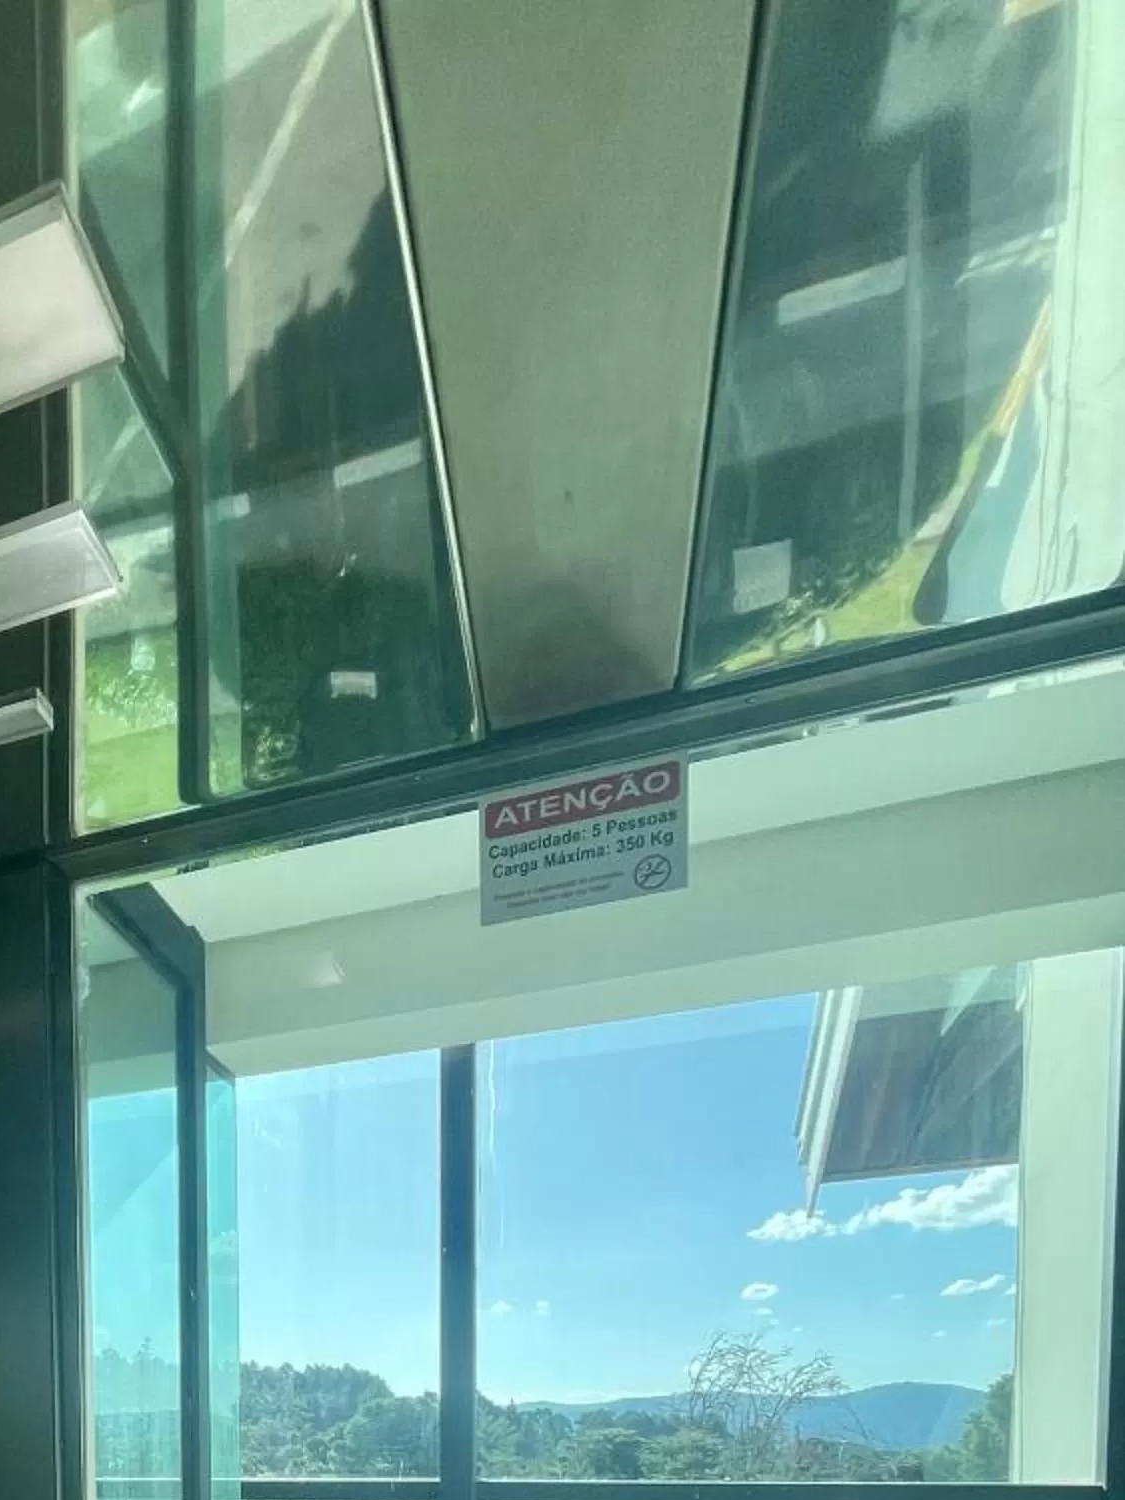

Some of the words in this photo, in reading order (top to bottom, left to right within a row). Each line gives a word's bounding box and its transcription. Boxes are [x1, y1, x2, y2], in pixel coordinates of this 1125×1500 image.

[494, 769, 671, 829] ATENÇÃO
[488, 829, 586, 860] Capacidade:
[592, 823, 602, 838] 5
[607, 809, 679, 835] Pessoas
[492, 858, 538, 879] Carga
[543, 843, 611, 869] Máxima:
[616, 835, 645, 854] 350
[650, 830, 674, 848] Kg
